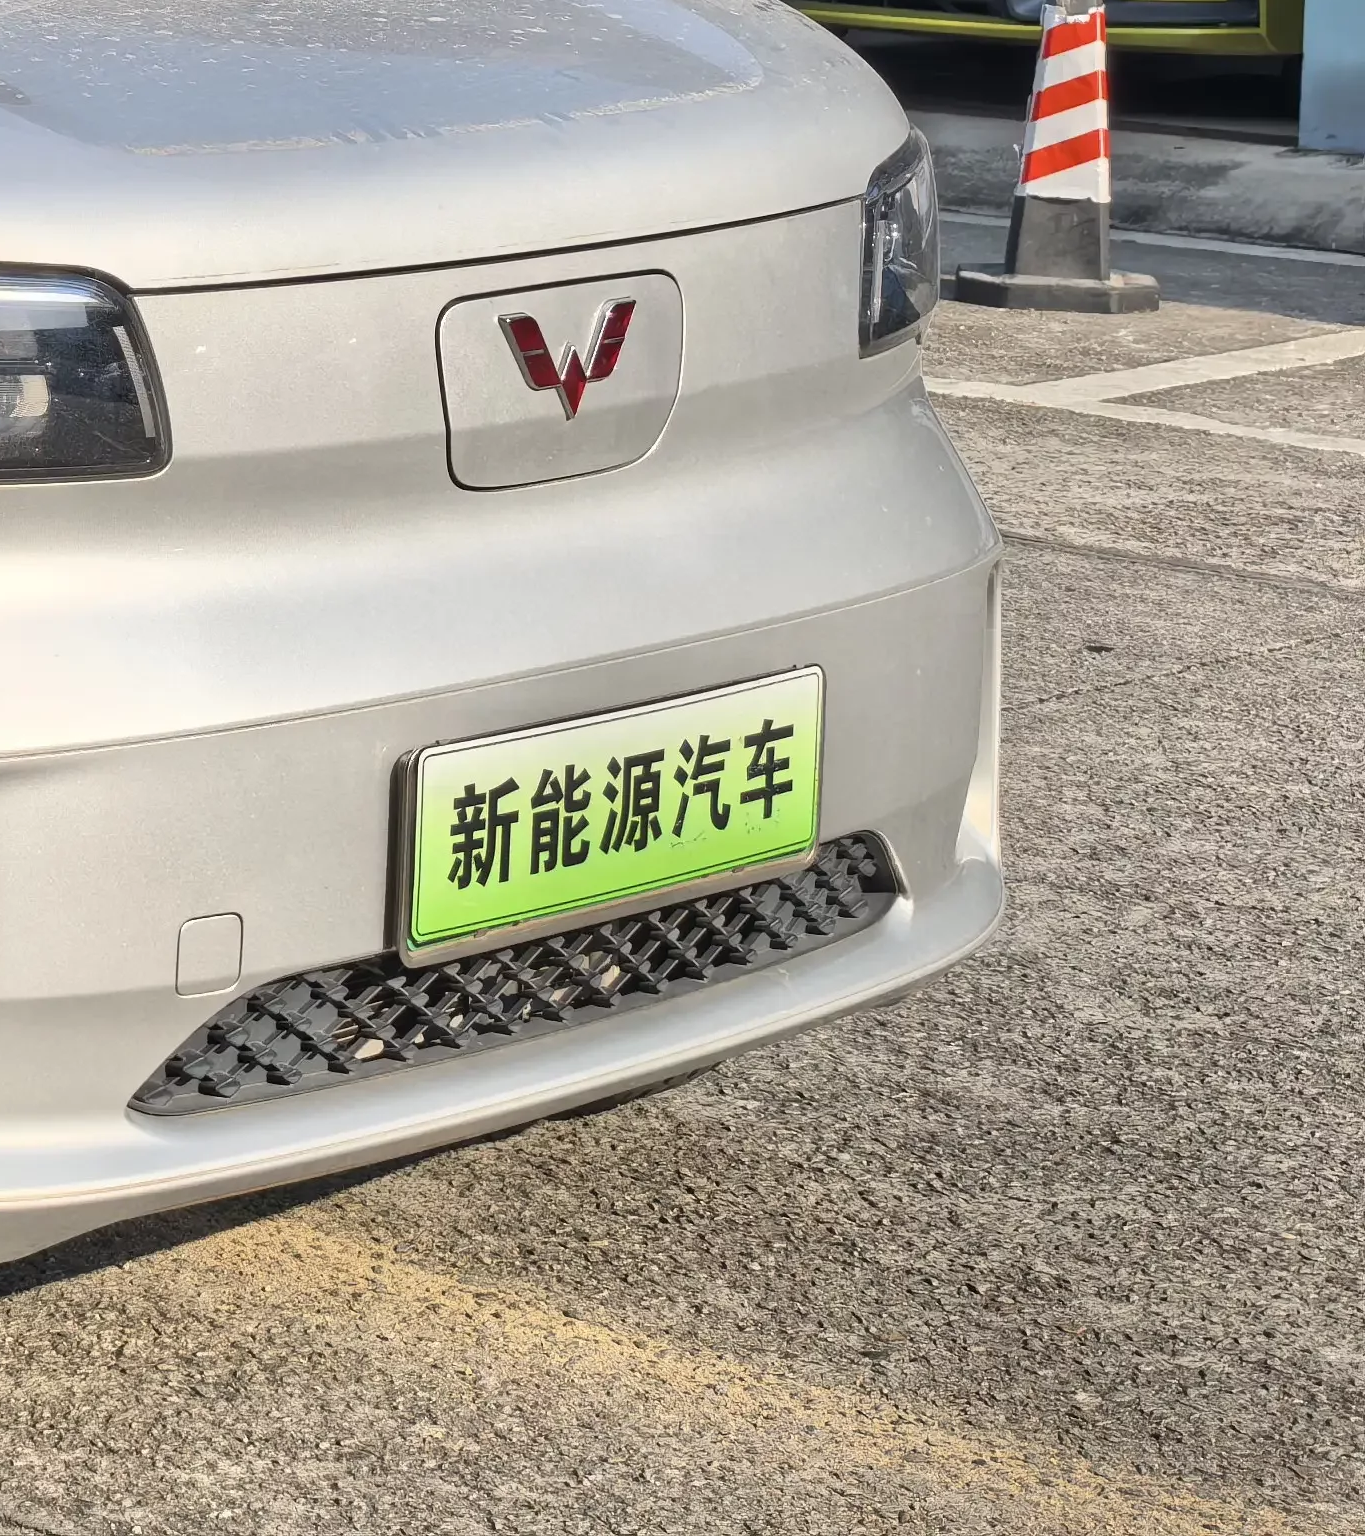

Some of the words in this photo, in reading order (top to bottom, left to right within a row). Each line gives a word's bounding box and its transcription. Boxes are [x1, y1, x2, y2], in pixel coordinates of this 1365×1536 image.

[447, 718, 794, 891] 新能源汽车
